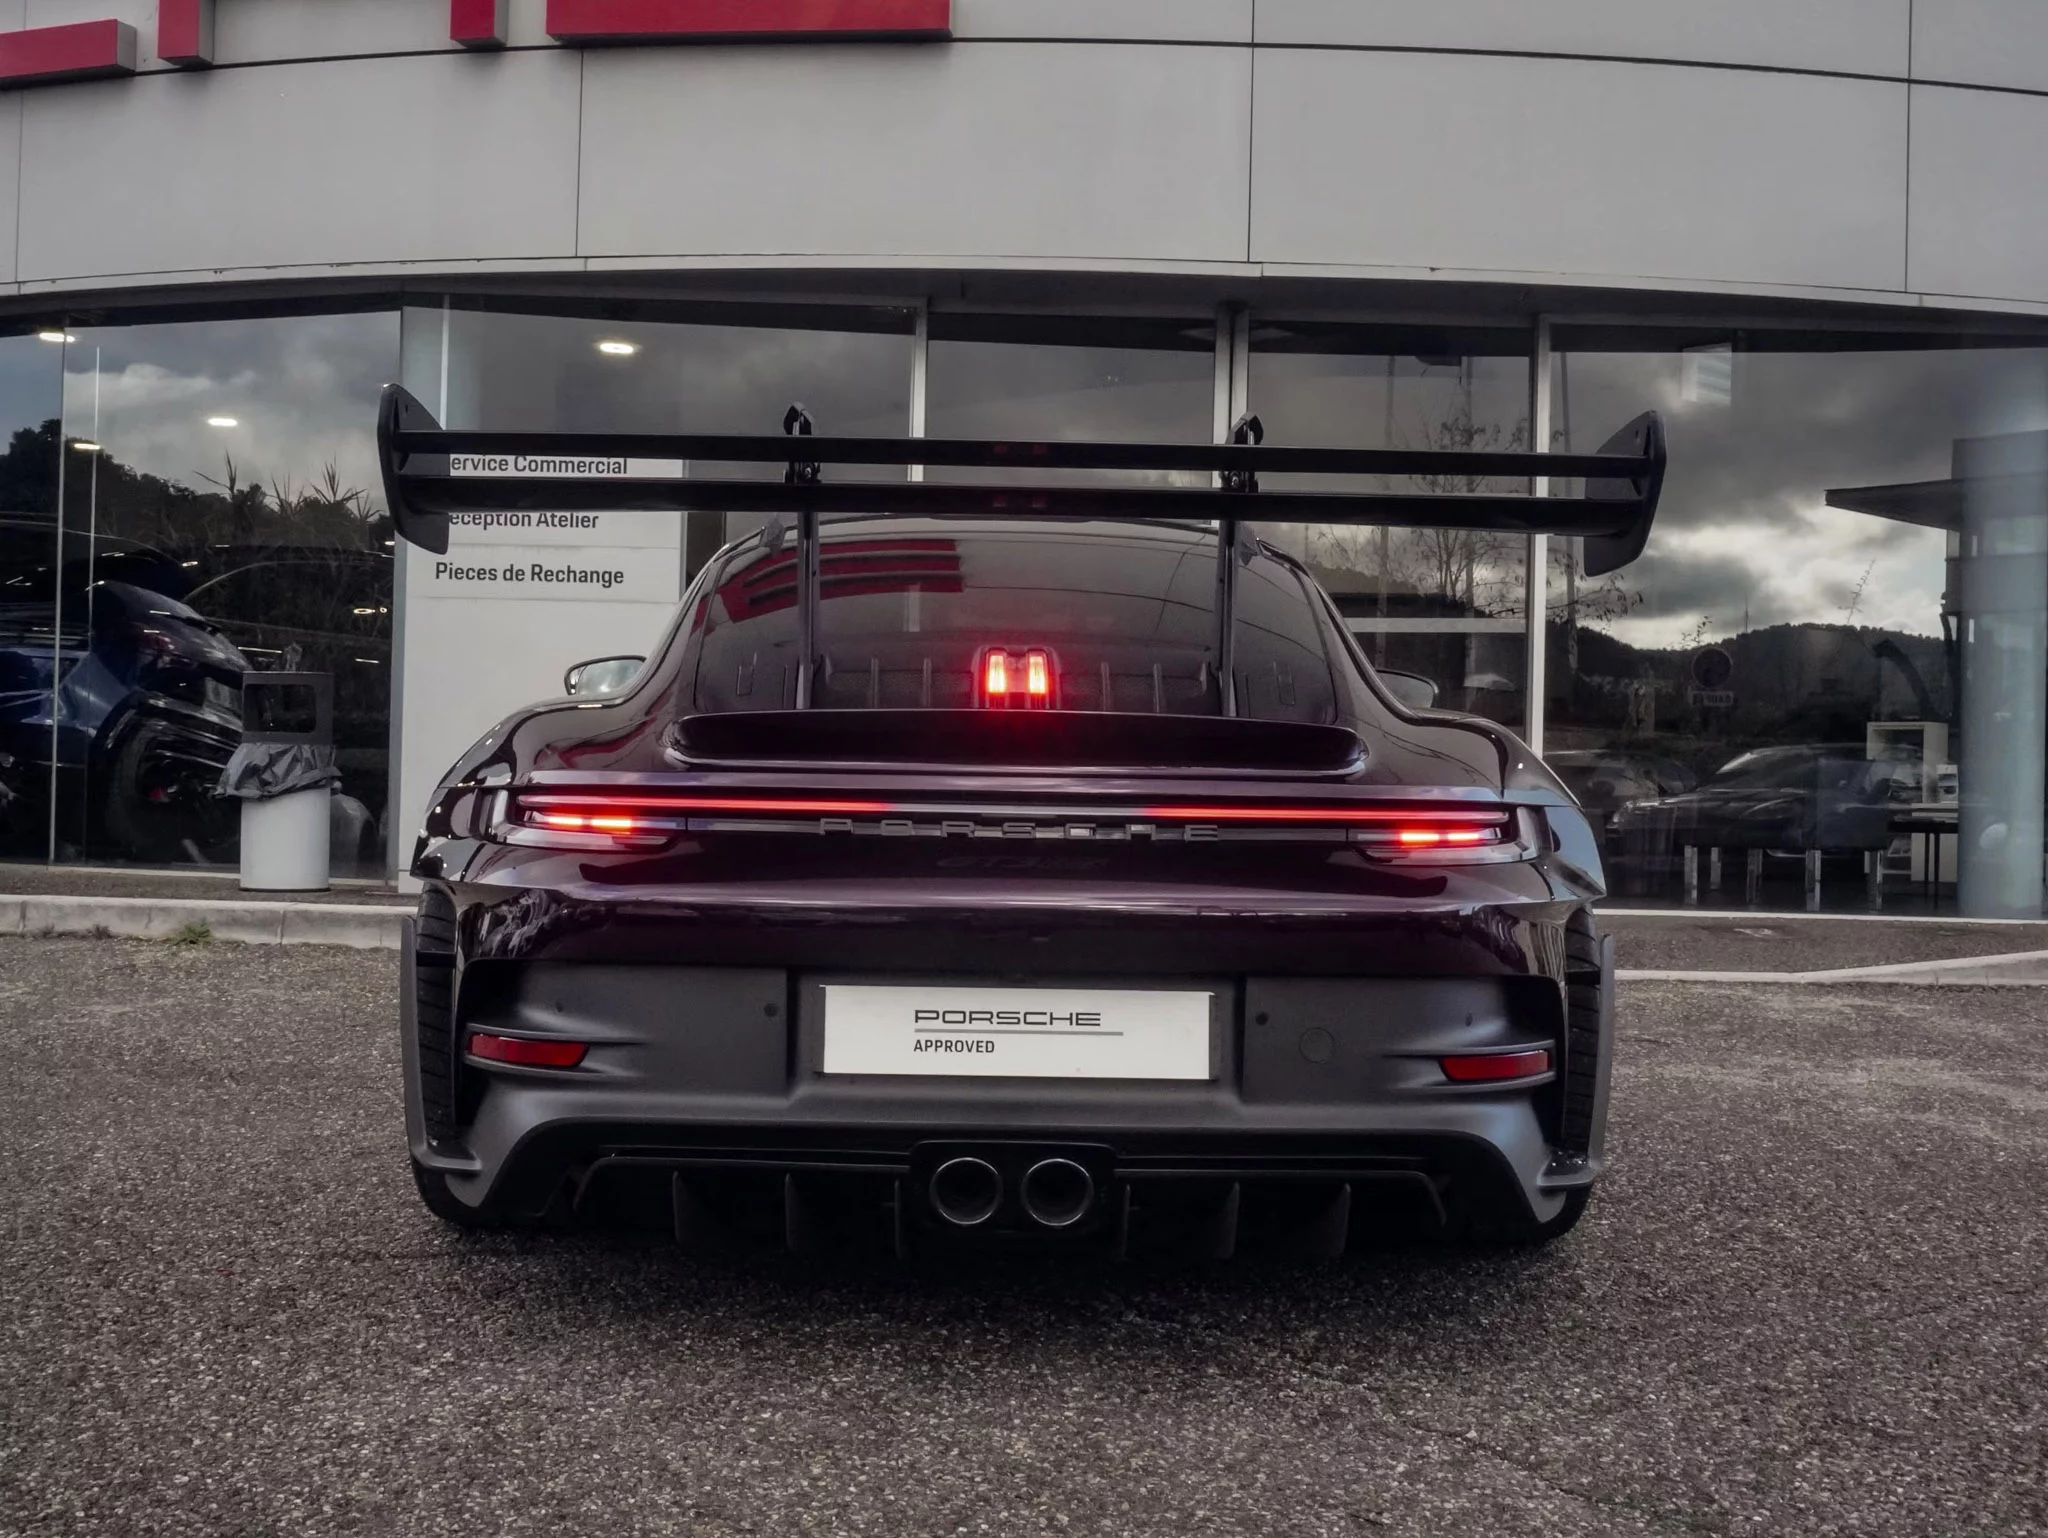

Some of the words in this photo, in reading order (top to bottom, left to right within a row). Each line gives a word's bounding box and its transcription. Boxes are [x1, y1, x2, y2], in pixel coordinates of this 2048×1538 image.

[450, 455, 509, 472] ervice
[513, 455, 628, 475] Commercial
[449, 512, 532, 531] eception
[535, 512, 600, 529] Atelier
[434, 561, 498, 582] Pieces
[502, 563, 526, 582] de
[530, 563, 625, 589] Rechange
[819, 817, 1219, 842] PORSCHE
[913, 1008, 1102, 1027] PORSCHE
[912, 1038, 996, 1054] APPROVED
